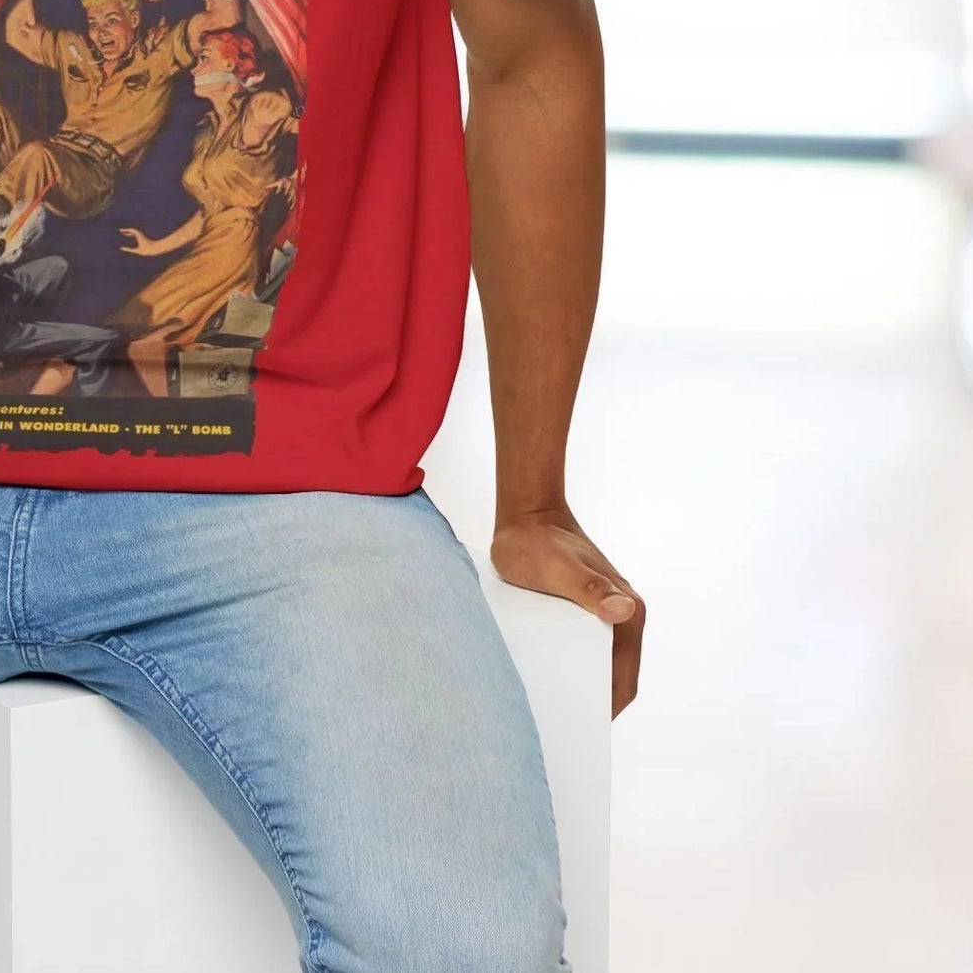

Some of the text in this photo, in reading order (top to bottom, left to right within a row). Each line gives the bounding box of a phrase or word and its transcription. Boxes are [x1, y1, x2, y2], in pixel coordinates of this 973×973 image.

[0, 421, 14, 430] IN
[19, 421, 120, 433] WONDERLAND
[135, 425, 160, 435] THE
[166, 424, 187, 435] "L"
[192, 425, 232, 435] BOMB
